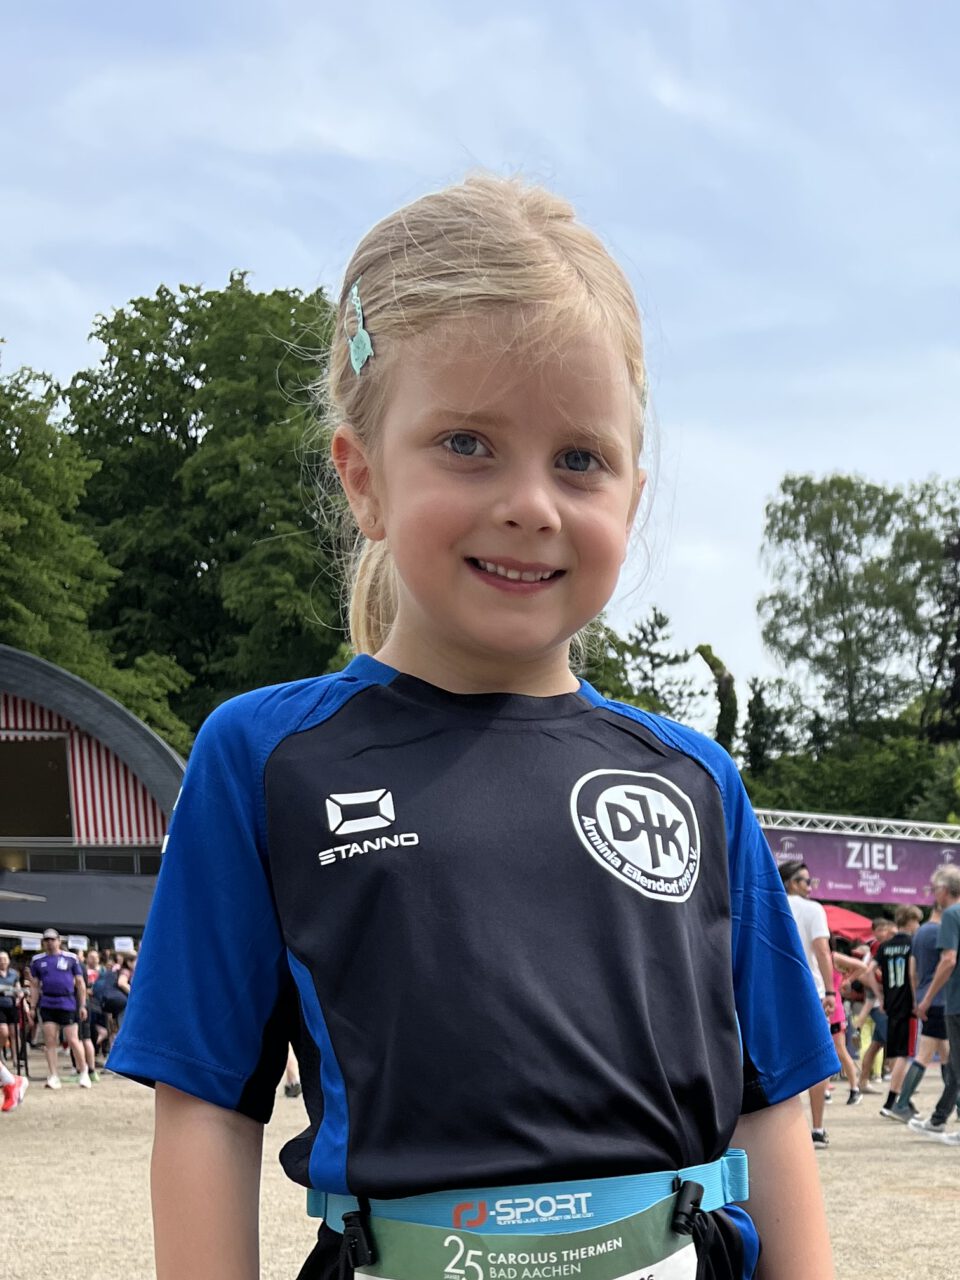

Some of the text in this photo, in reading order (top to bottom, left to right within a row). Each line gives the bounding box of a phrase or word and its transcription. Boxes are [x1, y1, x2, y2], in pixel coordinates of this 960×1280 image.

[581, 815, 622, 869] Arminia
[605, 791, 685, 869] DJK
[318, 832, 419, 866] STANNO
[846, 842, 898, 871] ZIEL
[487, 1237, 623, 1265] CAROLUS THERMEN
[489, 1263, 581, 1279] BAD AACHEN
